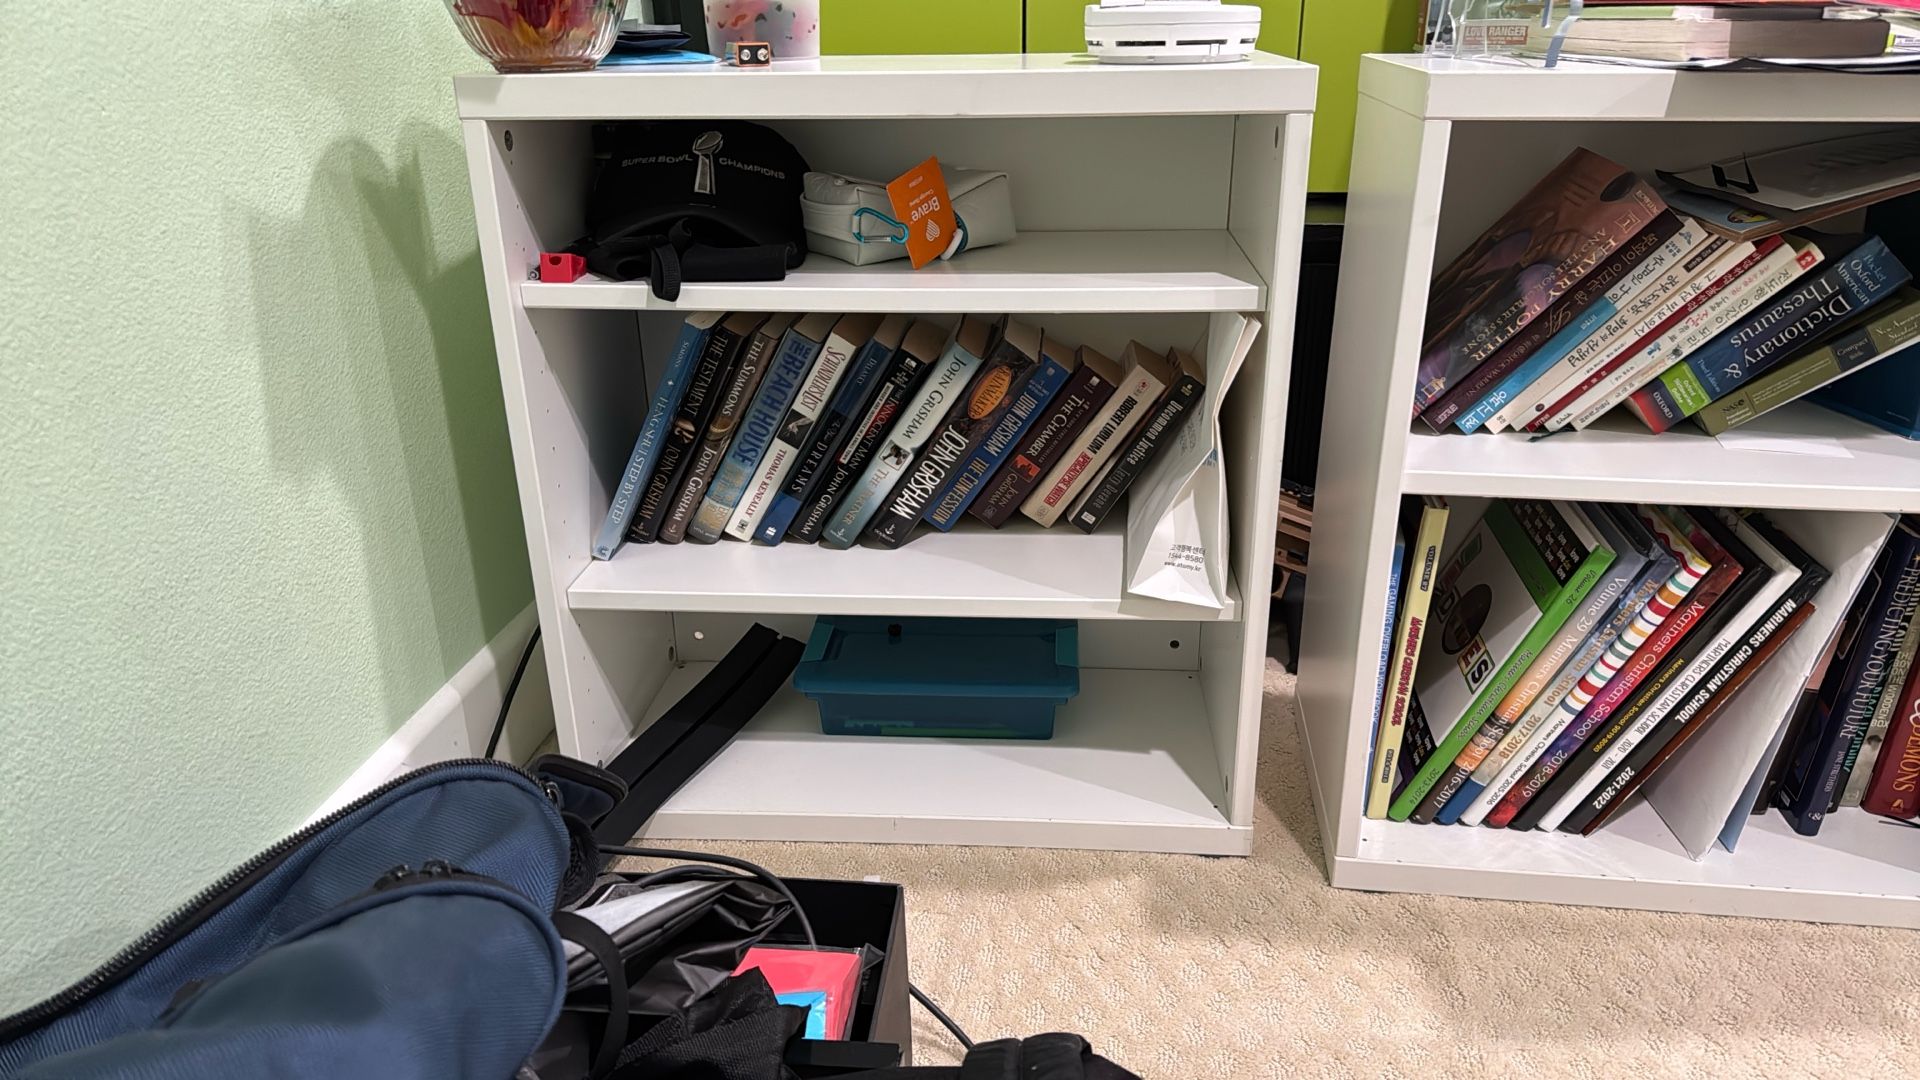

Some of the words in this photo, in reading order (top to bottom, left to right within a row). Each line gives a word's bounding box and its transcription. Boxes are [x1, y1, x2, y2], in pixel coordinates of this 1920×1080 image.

[621, 156, 656, 168] SUPER
[657, 154, 694, 164] BOWL
[718, 157, 786, 180] CHAMPIONS
[911, 196, 941, 222] Brave
[1622, 233, 1659, 265] 목적이
[1542, 235, 1620, 301] HARRY
[1630, 254, 1665, 286] 주님은
[1704, 269, 1719, 283] 그
[1836, 262, 1870, 306] American
[1850, 259, 1881, 292] Oxford
[1863, 254, 1887, 282] Pocket
[1608, 283, 1632, 304] 나의
[1681, 282, 1704, 304] 청년
[1634, 301, 1680, 338] 바보의사
[1713, 298, 1755, 332] 인간이
[1730, 278, 1840, 348] Thesaurus
[709, 336, 729, 359] THE
[1468, 302, 1542, 364] POTTER
[1743, 293, 1853, 368] Dictionary
[747, 340, 765, 363] THE
[788, 340, 813, 359] THE
[1567, 339, 1601, 368] 선생님
[684, 357, 719, 416] TESTAMENT
[762, 352, 806, 414] BEACH
[938, 355, 967, 389] JOHN
[1723, 363, 1743, 379] &
[722, 363, 756, 417] SUMMONS
[1011, 391, 1039, 420] JOHN
[1060, 394, 1085, 416] THE
[1653, 391, 1674, 419] OXFORD
[650, 397, 669, 428] FENG
[863, 397, 900, 449] INNOCENT
[902, 389, 944, 439] GRISHAM
[1111, 395, 1139, 427] ROBERT
[1149, 400, 1184, 440] Uncommon
[638, 428, 656, 456] SHUI
[732, 408, 776, 468] HOUSE
[928, 424, 970, 469] JOHN
[983, 414, 1023, 457] GRISHAM
[1026, 414, 1068, 457] CHAMBER
[1087, 421, 1117, 455] LUDLUM
[1126, 435, 1154, 465] Justice
[628, 455, 645, 483] STEP
[660, 444, 681, 475] JOHN
[695, 446, 718, 477] JOHN
[765, 449, 788, 481] THOMAS
[791, 441, 828, 493] DREAMS
[848, 447, 869, 470] MAN
[968, 457, 991, 477] THE
[1061, 452, 1092, 486] APOCALYPSE
[622, 483, 635, 499] BY
[827, 467, 849, 495] JOHN
[870, 468, 890, 488] THE
[889, 460, 946, 520] GRISHAM
[989, 473, 1018, 505] GRISHAM
[1045, 484, 1065, 505] WATCH
[612, 498, 628, 525] STEP
[640, 474, 668, 520] GRISHAM
[673, 476, 703, 521] GRISHAM
[745, 479, 770, 518] KENEALLY
[932, 472, 979, 525] CONFESSION
[999, 487, 1019, 508] JOHN
[801, 494, 833, 535] GRISHAM
[1167, 551, 1204, 564] 1544-8580
[1424, 546, 1436, 582] VOLUME
[1390, 574, 1398, 587] THE
[1575, 569, 1597, 593] Volume
[1587, 577, 1629, 616] Volume
[1385, 588, 1397, 624] GAMING
[1566, 593, 1578, 605] 26
[1612, 578, 1660, 626] Mariners
[1873, 566, 1920, 652] PREDICTING
[1405, 616, 1424, 657] MARINERS
[1576, 616, 1594, 633] 29
[1652, 600, 1706, 654] Mariners
[1748, 597, 1798, 648] MARINERS
[1379, 623, 1393, 674] OVERLOAD
[1507, 649, 1534, 680] Mariners
[1535, 634, 1578, 681] Mariners
[1572, 627, 1618, 673] Christian
[1694, 637, 1733, 677] MARINERS
[1605, 653, 1657, 704] Christian
[1659, 657, 1686, 685] Mariners
[1706, 644, 1753, 693] CHRISTIAN
[1857, 652, 1889, 690] YOUR
[1476, 681, 1507, 716] Christian
[1498, 681, 1540, 725] Christian
[1543, 672, 1578, 708] School
[1638, 683, 1662, 707] Christian
[1656, 674, 1696, 714] CHRISTIAN
[1674, 688, 1710, 724] SCHOOL
[1879, 684, 1899, 719] WOODEN
[1391, 695, 1406, 727] SCHOOL
[1457, 716, 1479, 740] School
[1573, 702, 1611, 740] School
[1619, 705, 1640, 727] School
[1634, 710, 1661, 737] SCHOOL
[1839, 691, 1872, 740] FUTURE
[1870, 719, 1890, 729] BOX
[1472, 725, 1504, 760] School
[1498, 713, 1542, 760] 2017-2018
[1544, 717, 1567, 740] Mariners
[1593, 724, 1622, 753] 2019-2020
[1524, 740, 1547, 764] Christian
[1409, 767, 1440, 805] 2013-2014
[1432, 761, 1473, 809] 2016-2017
[1511, 763, 1529, 781] School
[1521, 748, 1569, 798] 2018-2019
[1592, 765, 1636, 810] 2021-2022
[1486, 777, 1514, 806] 2015-2016
